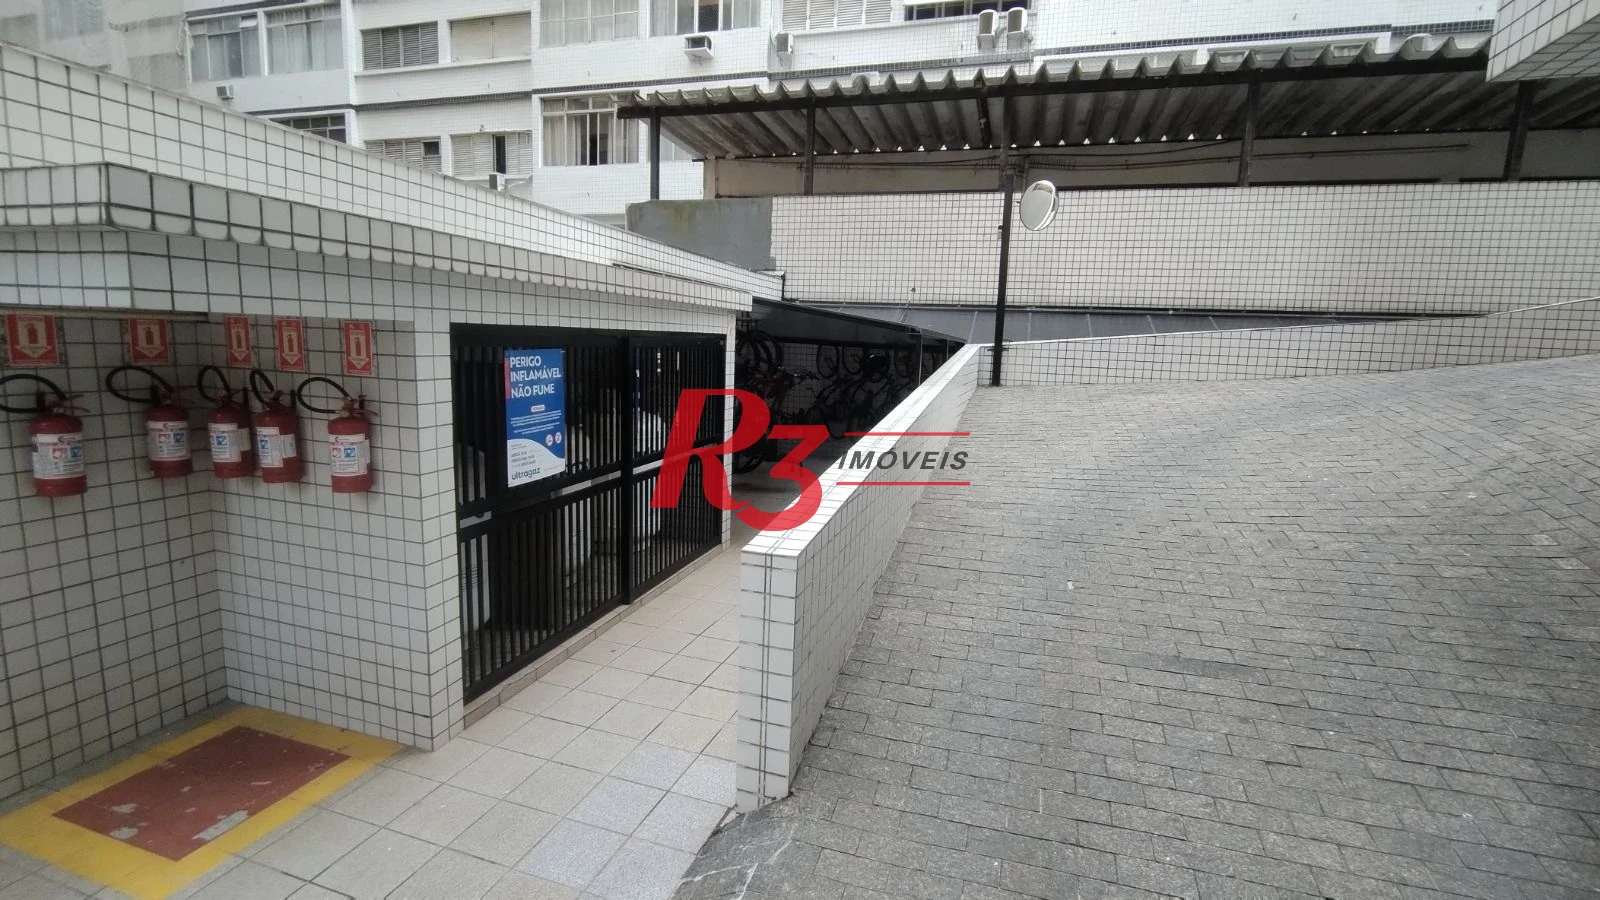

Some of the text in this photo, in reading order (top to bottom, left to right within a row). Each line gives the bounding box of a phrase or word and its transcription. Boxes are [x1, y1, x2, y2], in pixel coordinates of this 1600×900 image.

[510, 356, 541, 368] PERIGO
[510, 366, 561, 383] INFLAMÁVEL
[511, 383, 555, 399] NÃO FUME
[511, 467, 541, 480] ultragaz
